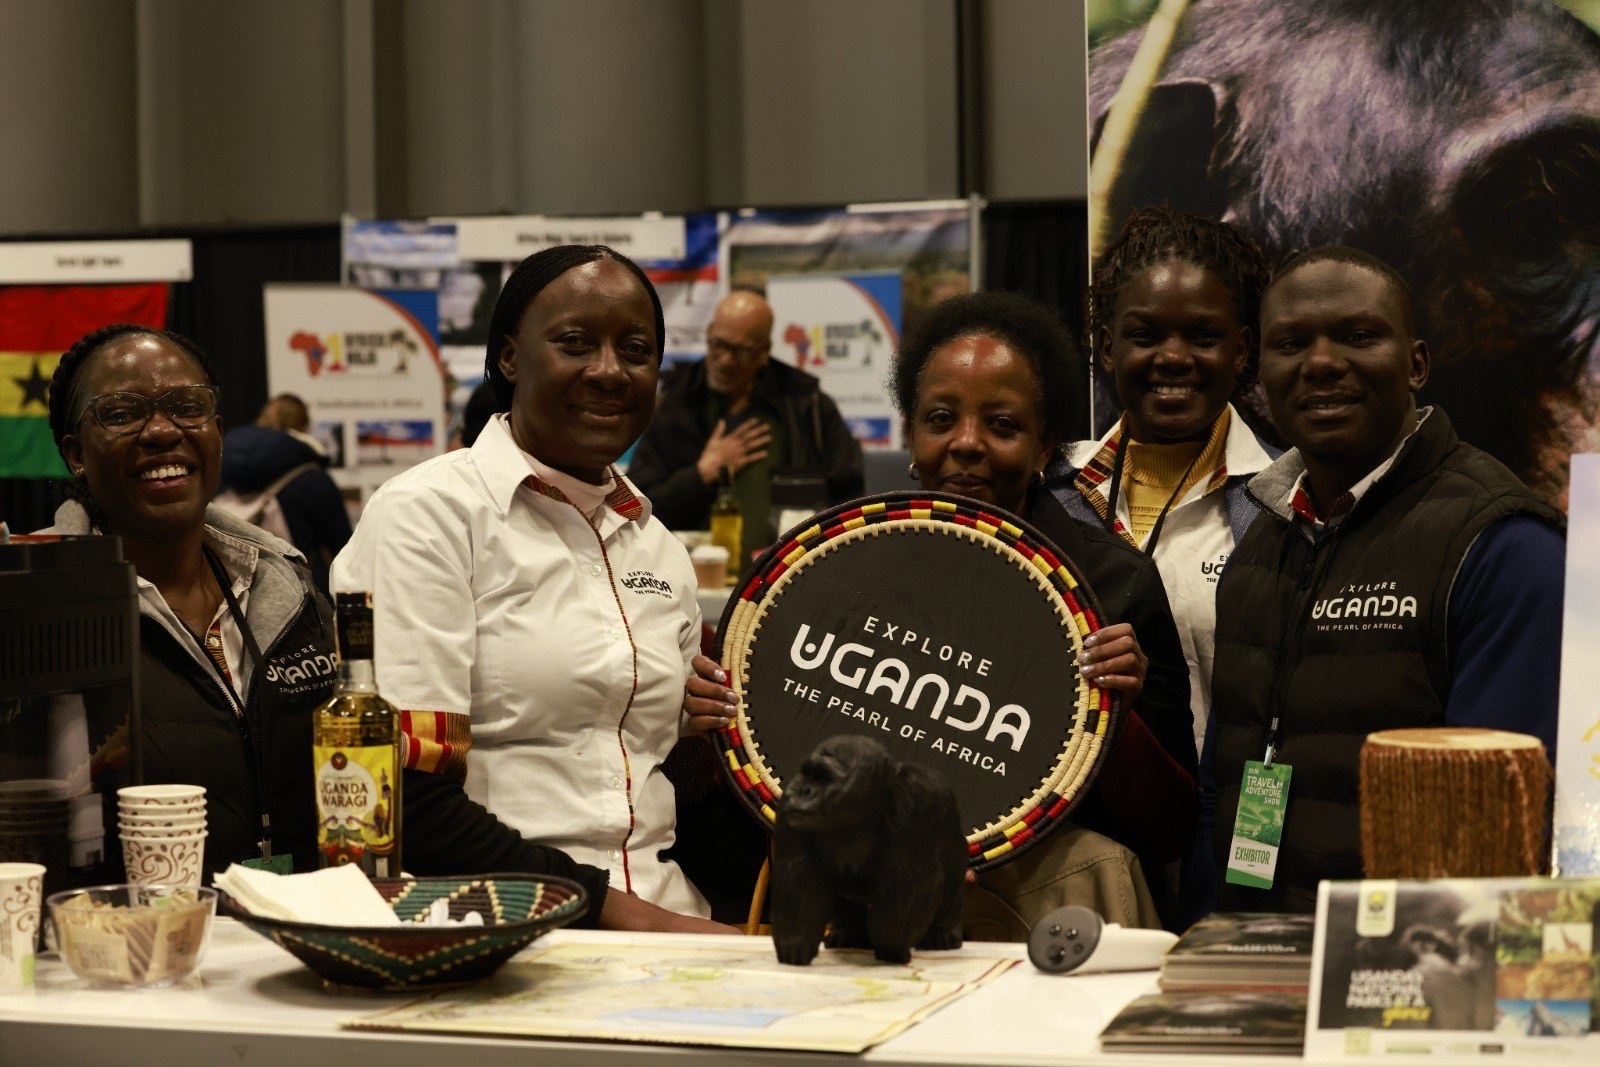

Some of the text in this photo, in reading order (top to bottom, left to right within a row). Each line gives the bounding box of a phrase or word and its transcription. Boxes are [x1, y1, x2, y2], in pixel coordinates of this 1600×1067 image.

[620, 576, 673, 594] UGANDA
[1311, 595, 1418, 620] UGANDA
[1362, 623, 1372, 631] OF
[1373, 622, 1404, 631] AFRICA
[863, 615, 993, 678] EXPLORE
[790, 623, 1032, 753] UGANDA
[783, 677, 1007, 777] THE PEARL OF AFRICA
[1245, 786, 1282, 798] ADVENTURE
[322, 796, 368, 808] WARAGI
[1263, 797, 1281, 806] SHOW
[1235, 847, 1271, 865] EXHIBITOR
